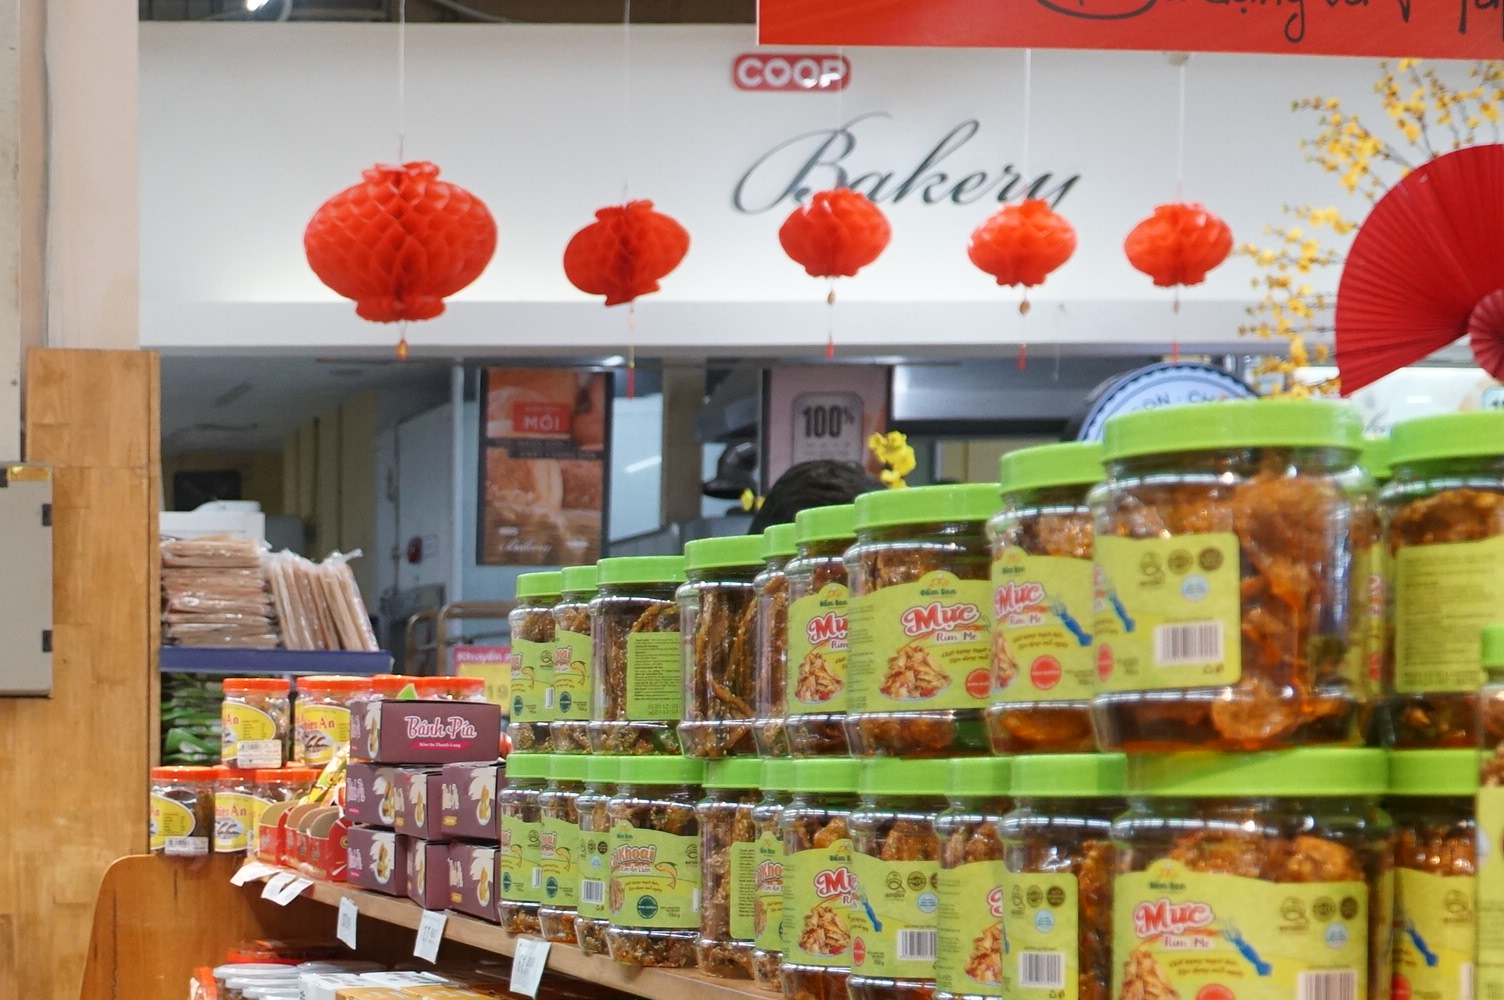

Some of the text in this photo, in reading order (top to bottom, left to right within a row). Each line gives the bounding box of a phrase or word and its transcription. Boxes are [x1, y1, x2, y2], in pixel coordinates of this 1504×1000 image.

[737, 57, 846, 88] COOP
[733, 112, 1081, 214] Bakery
[523, 413, 560, 432] MỚI
[802, 405, 855, 438] 100%
[901, 601, 981, 638] Mực
[936, 630, 979, 642] Rim Me
[404, 715, 477, 739] Bánh Pía
[617, 844, 657, 863] Khoai
[1134, 897, 1215, 938] Mực
